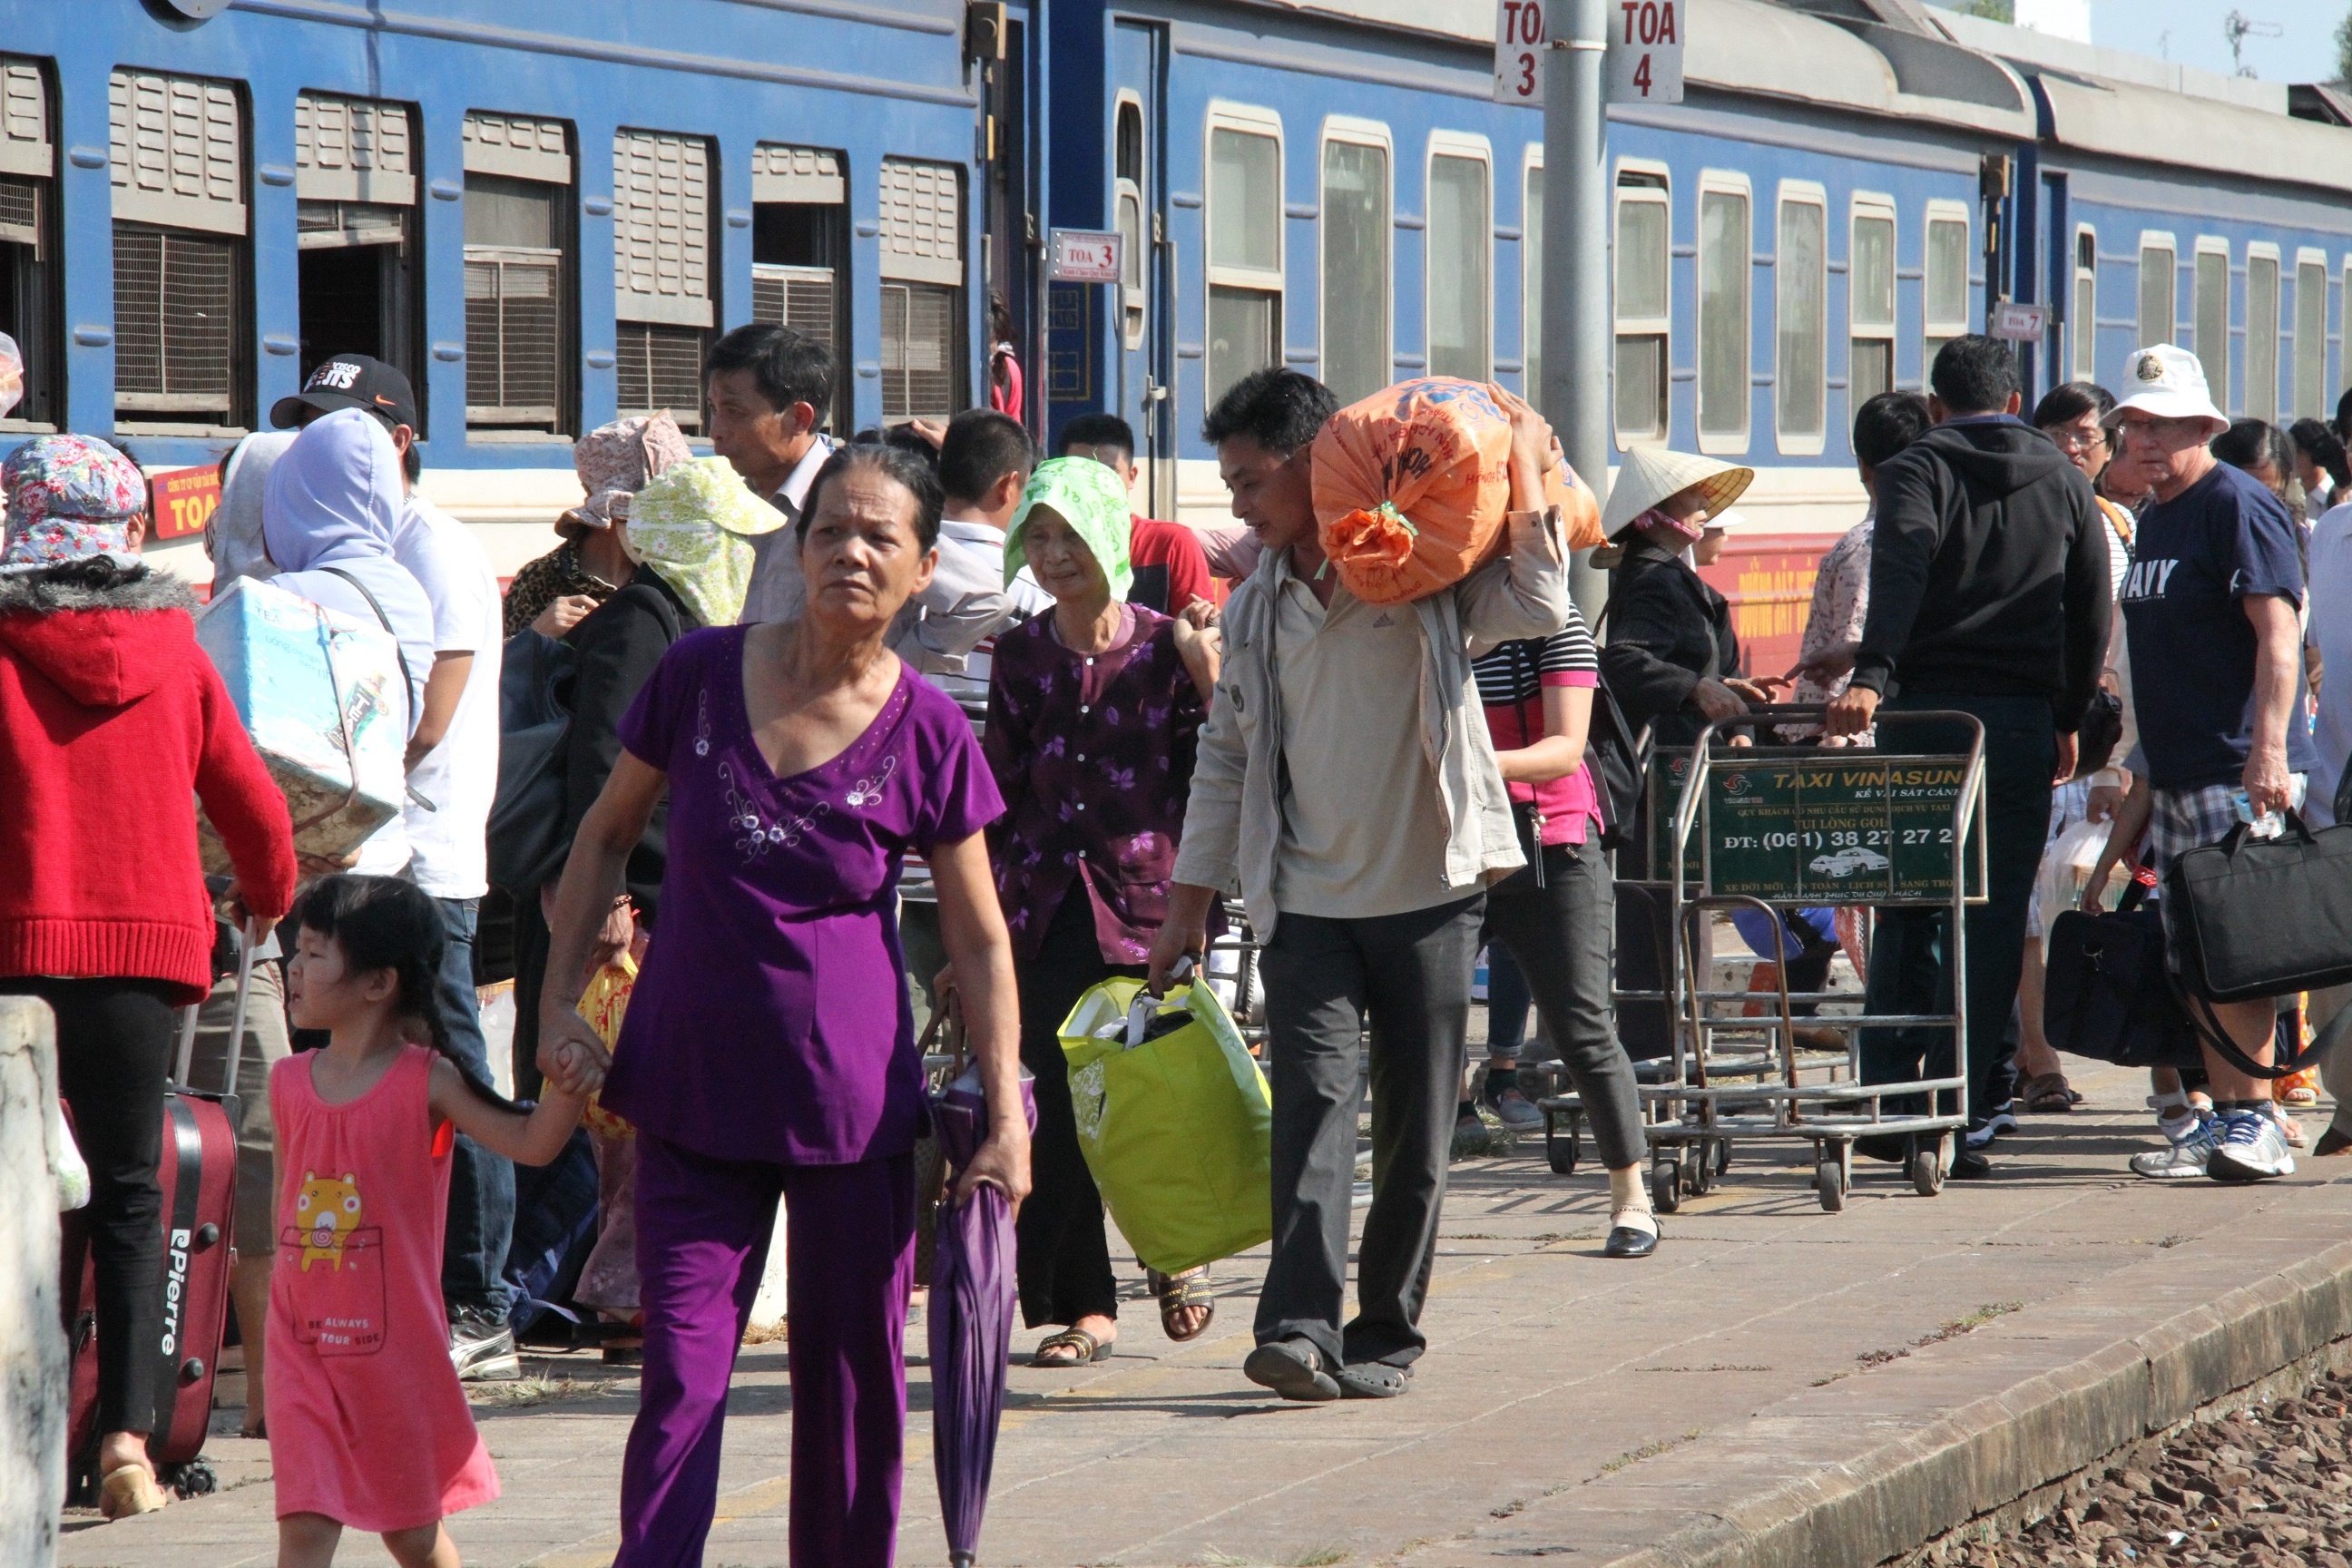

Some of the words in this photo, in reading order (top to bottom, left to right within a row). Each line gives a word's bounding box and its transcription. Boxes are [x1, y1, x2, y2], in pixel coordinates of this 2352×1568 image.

[1504, 1, 1545, 44] TO
[1622, 1, 1675, 44] TOA
[1517, 53, 1535, 96] 3
[1633, 54, 1651, 97] 4
[1069, 249, 1093, 263] TOA
[1098, 245, 1112, 269] 3
[2029, 314, 2039, 329] 7
[1773, 772, 1833, 789] TAXI
[1843, 769, 1964, 788] VINASUN
[1807, 807, 1826, 815] NHU
[1930, 803, 1951, 812] TAXI
[1763, 831, 1823, 851] (061)
[1831, 830, 1859, 847] 38
[1867, 829, 1896, 846] 27
[1903, 828, 1931, 845] 27
[1900, 879, 1929, 888] SANG
[162, 1249, 188, 1356] Pierre
[309, 1320, 322, 1329] BE
[325, 1317, 369, 1329] ALWAYS
[321, 1332, 350, 1346] YOUR
[355, 1332, 380, 1346] SIDE
